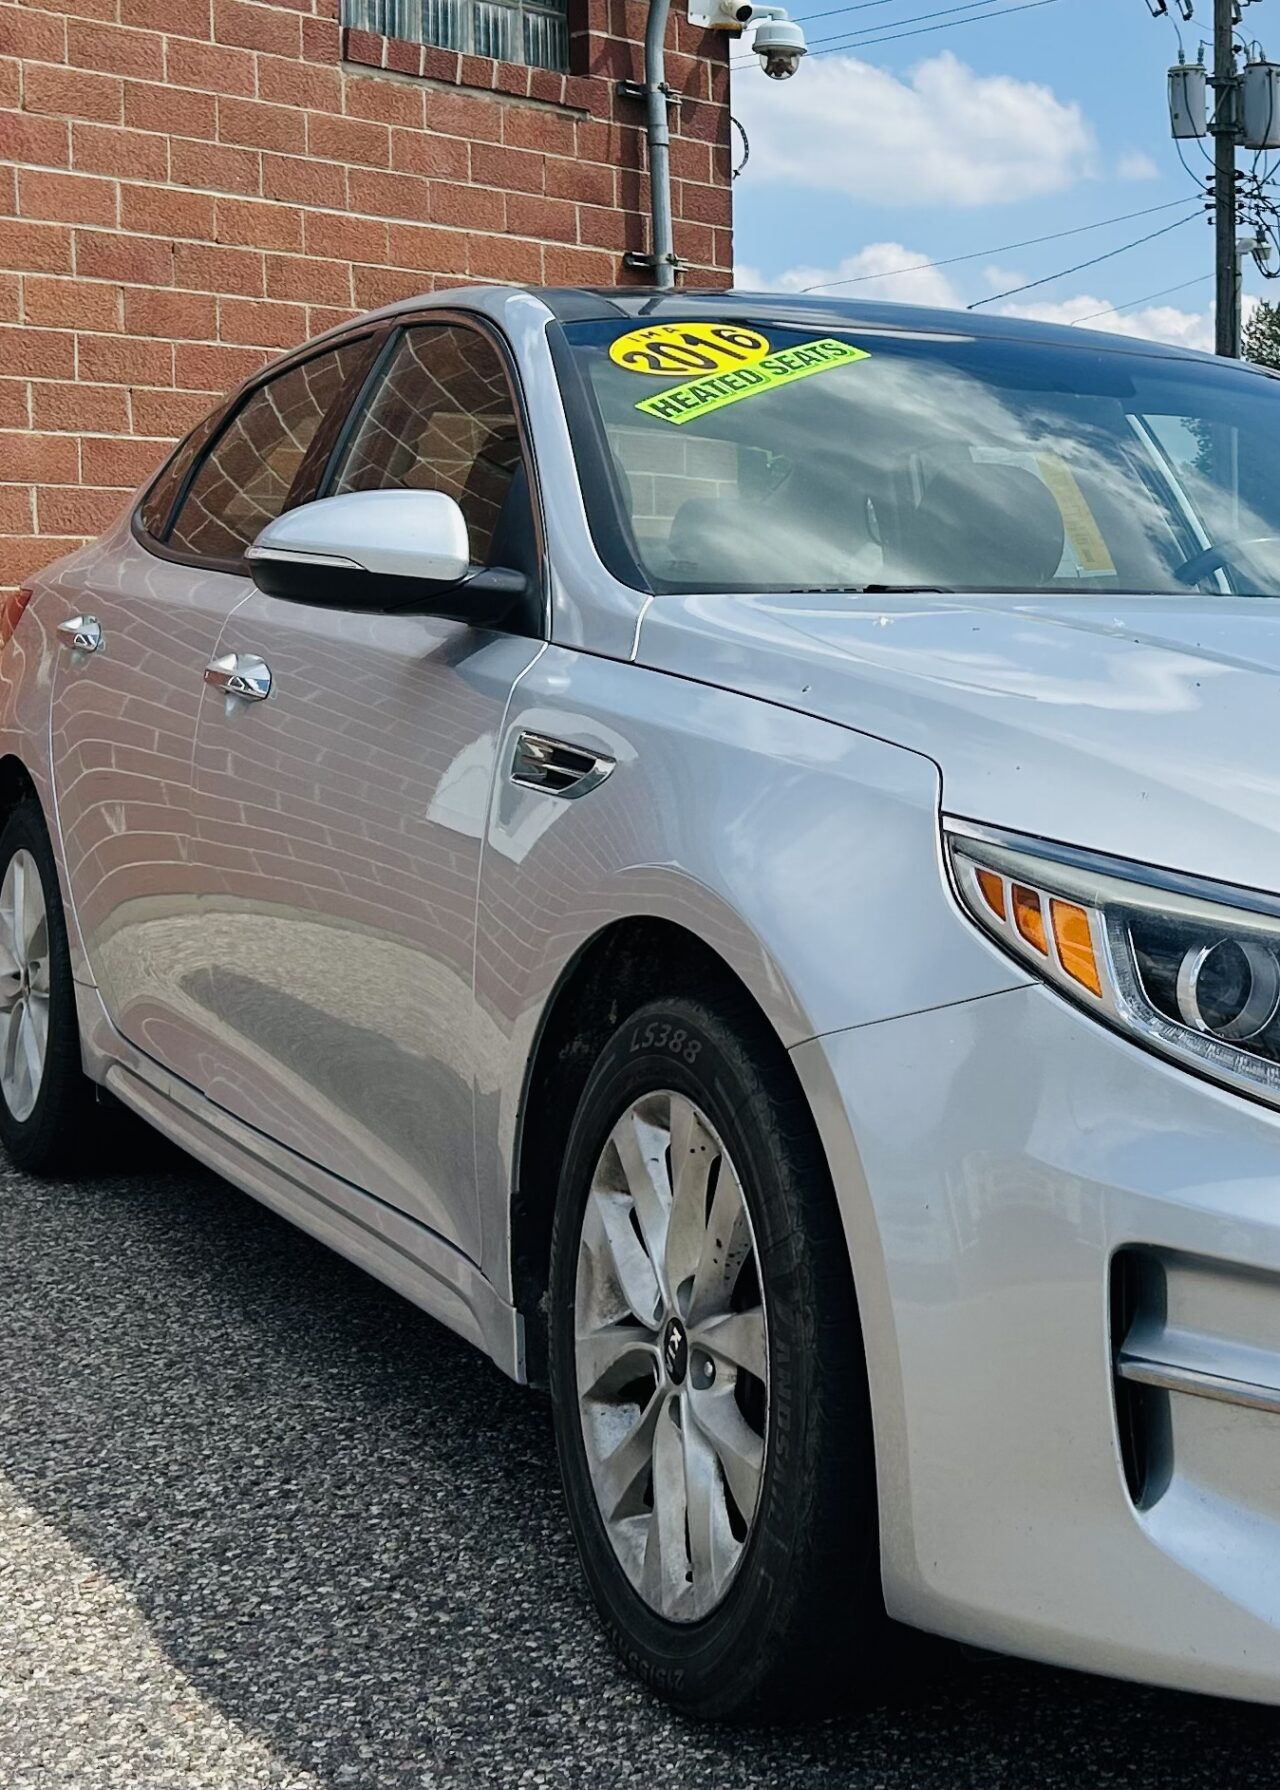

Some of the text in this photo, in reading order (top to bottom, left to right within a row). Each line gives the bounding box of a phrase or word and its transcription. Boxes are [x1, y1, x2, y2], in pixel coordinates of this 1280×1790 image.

[622, 328, 762, 371] 2016
[648, 342, 853, 418] HEATED SEATS
[629, 1022, 702, 1064] LS388
